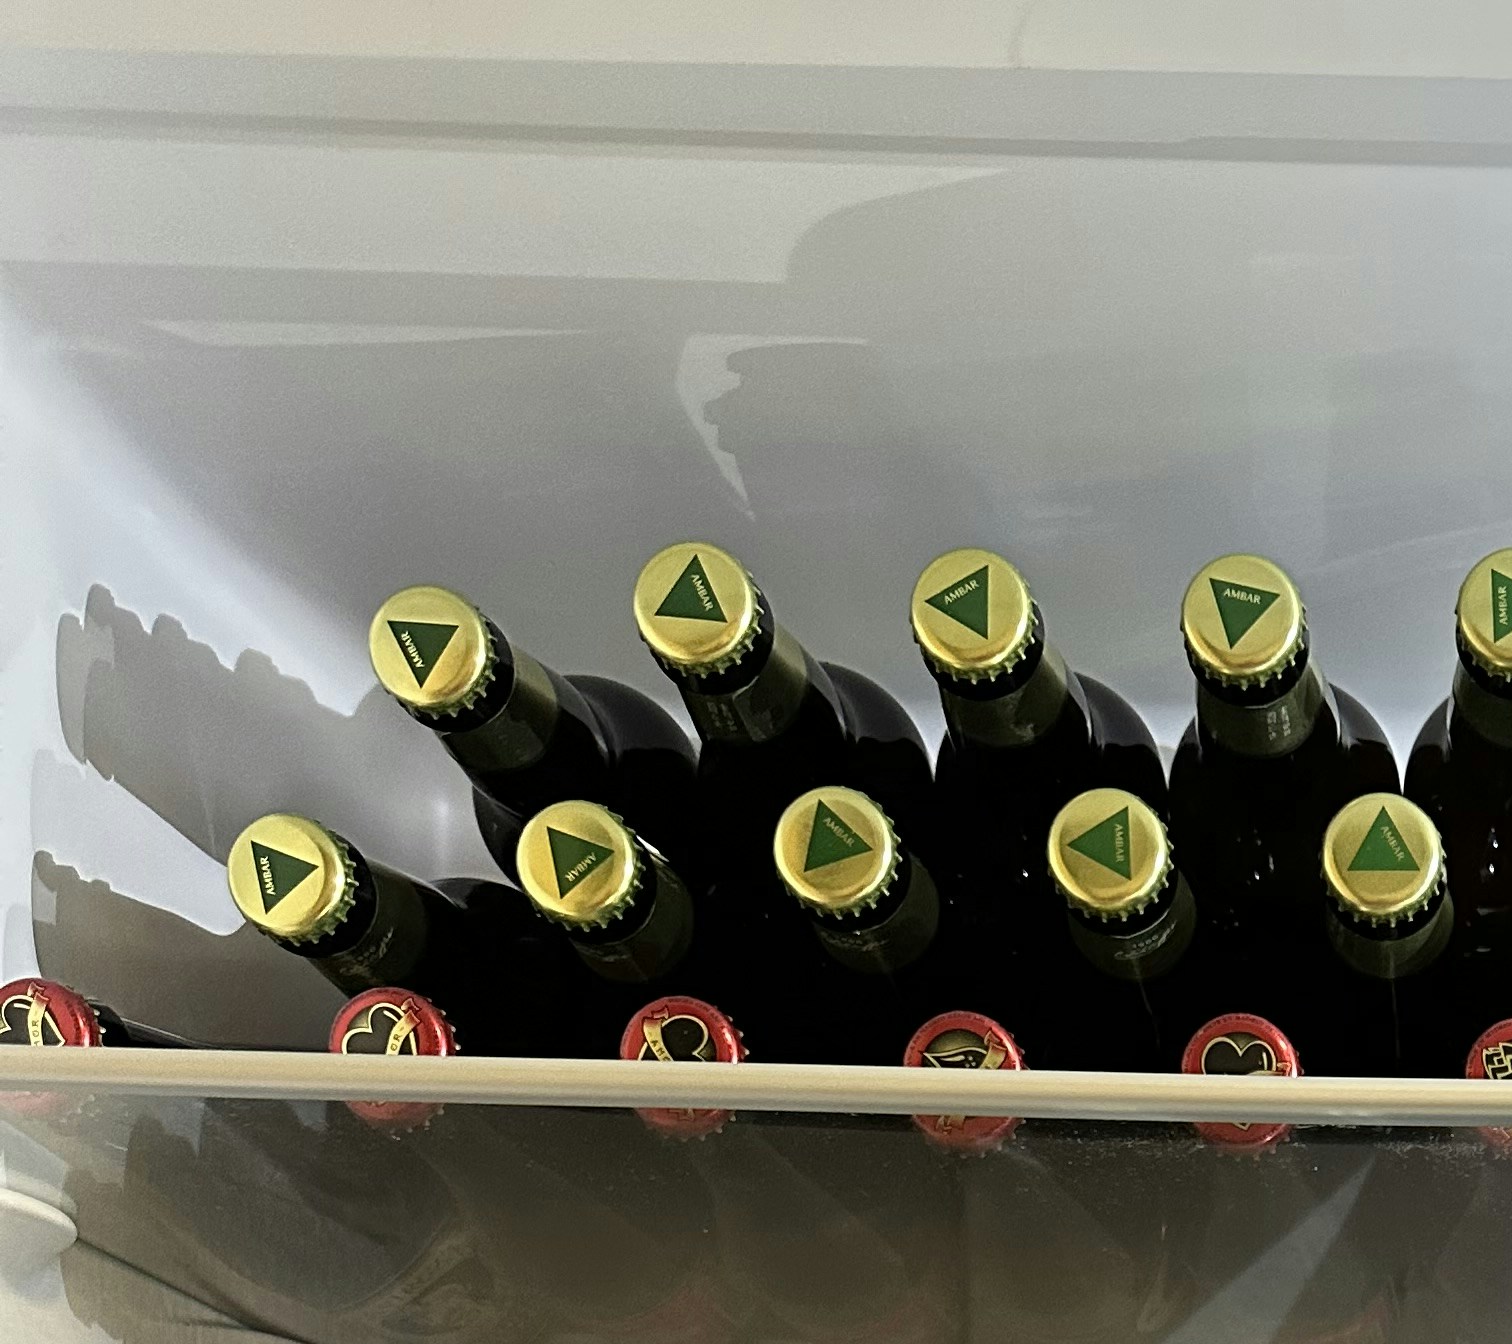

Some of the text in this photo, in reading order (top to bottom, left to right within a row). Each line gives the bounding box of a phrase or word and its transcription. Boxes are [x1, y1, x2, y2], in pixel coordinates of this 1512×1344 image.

[690, 573, 714, 613] AMBAR
[943, 578, 980, 605] AMBAR
[1223, 587, 1262, 605] AMBAR
[1498, 585, 1509, 625] AMBAR
[401, 630, 425, 670] AMBAR
[823, 815, 855, 848] AMBAR
[1113, 822, 1124, 863] AMBAR
[1380, 823, 1405, 863] AMBAR
[257, 855, 277, 897] AMBAR
[565, 851, 597, 883] AMBAR
